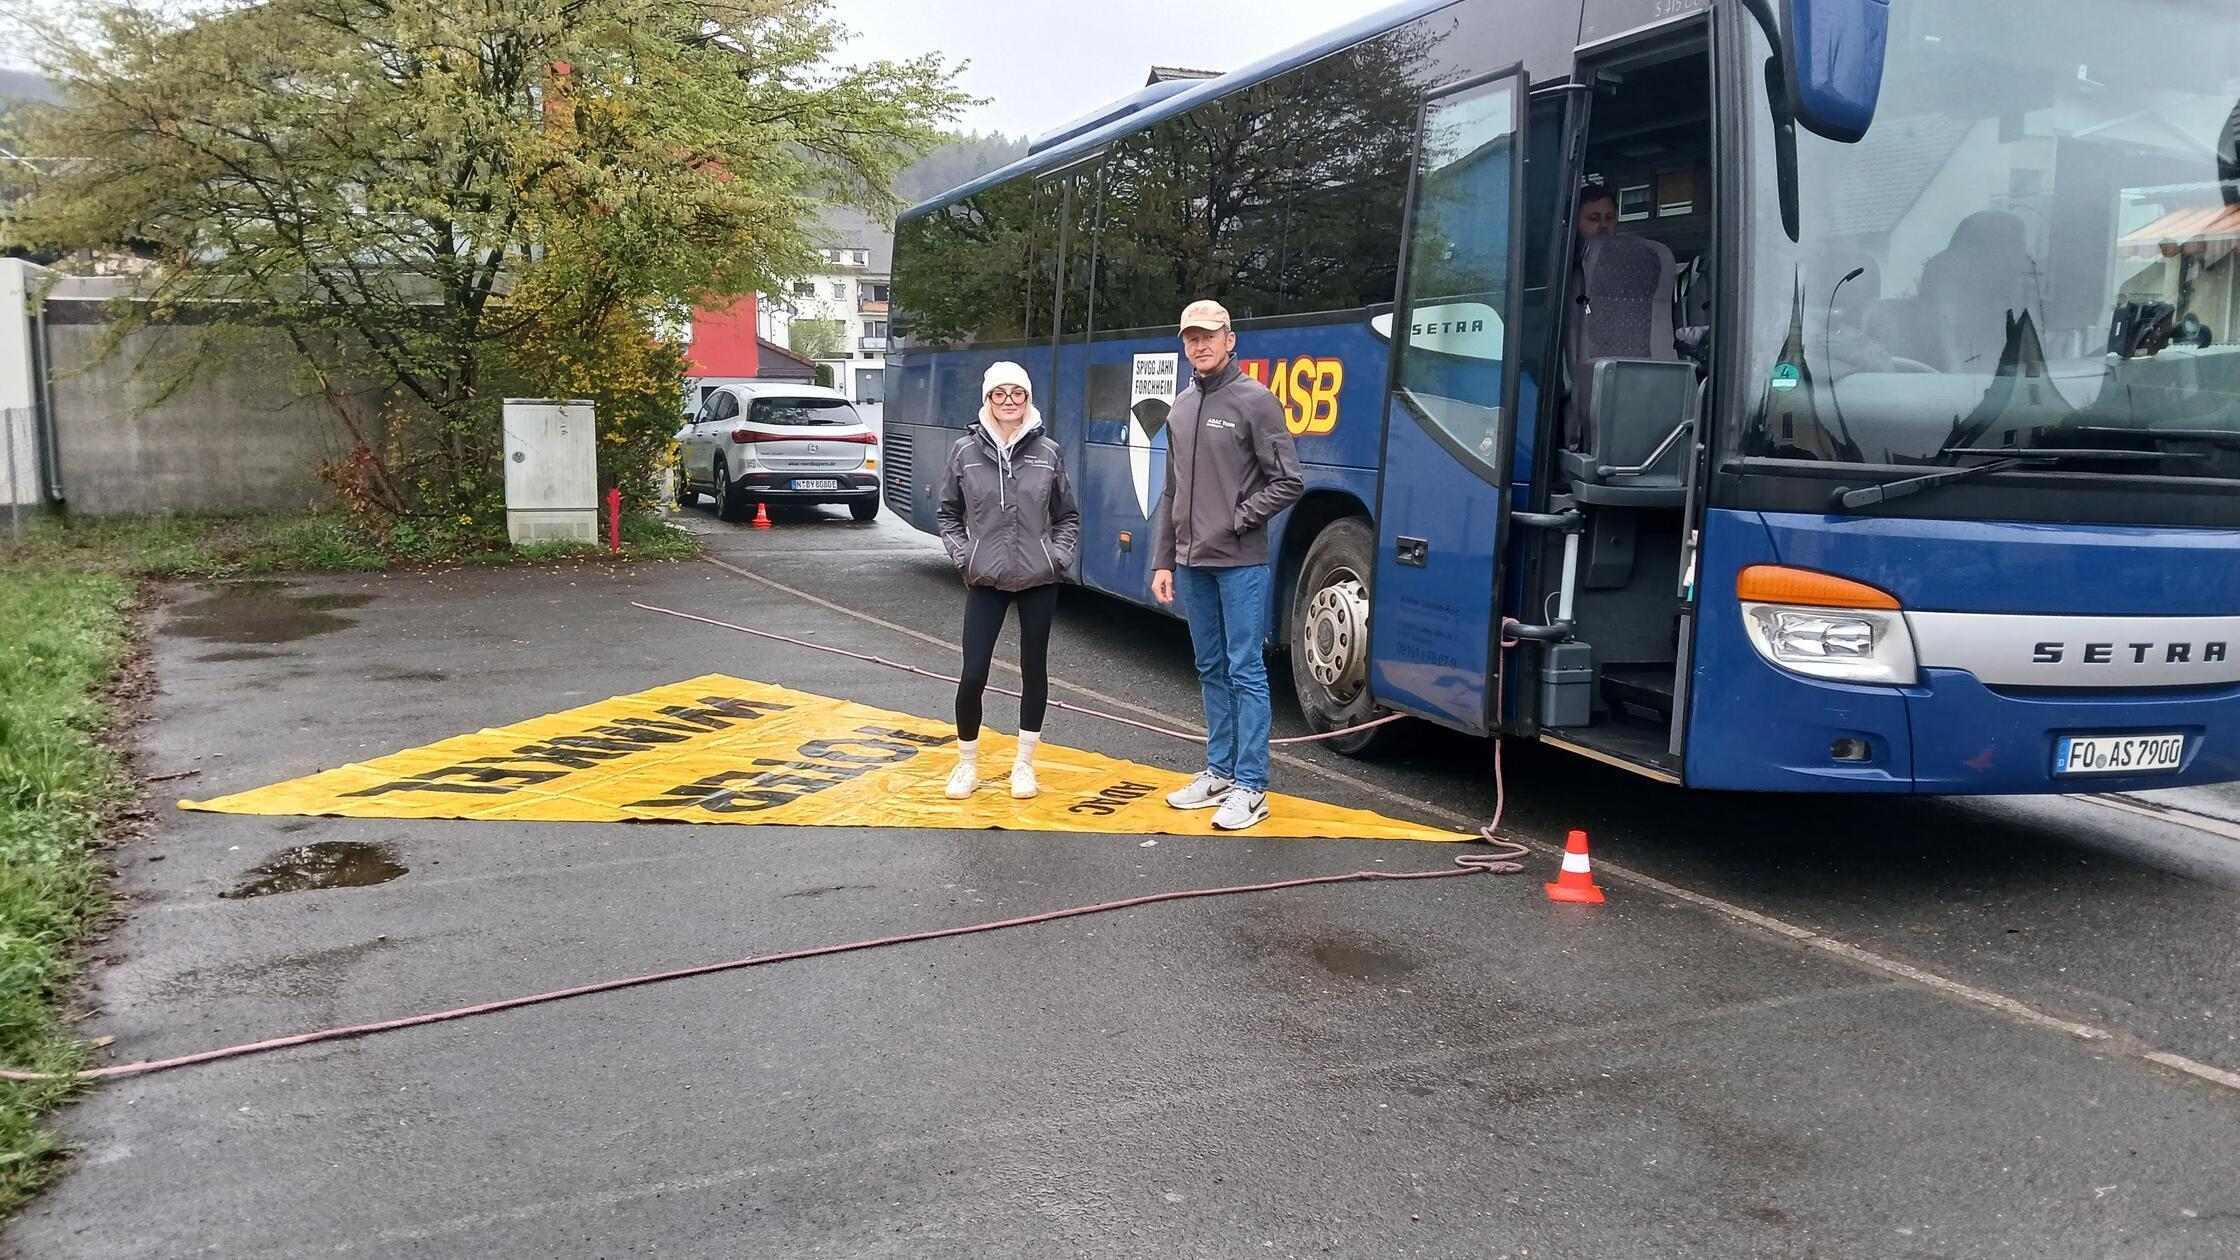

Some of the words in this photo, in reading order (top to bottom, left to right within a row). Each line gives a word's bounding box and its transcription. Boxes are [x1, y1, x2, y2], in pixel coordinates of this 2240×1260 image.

[1411, 319, 1484, 336] SETRA
[1135, 360, 1156, 375] SPVGG
[1156, 359, 1174, 375] JAHN
[1781, 365, 1790, 379] 4
[1134, 379, 1173, 395] FORCHHEIM
[2032, 641, 2227, 664] SETRA
[336, 695, 796, 798] WINKEL
[2069, 741, 2097, 768] FO
[618, 725, 958, 813] TOTER
[1067, 780, 1159, 816] ADAC
